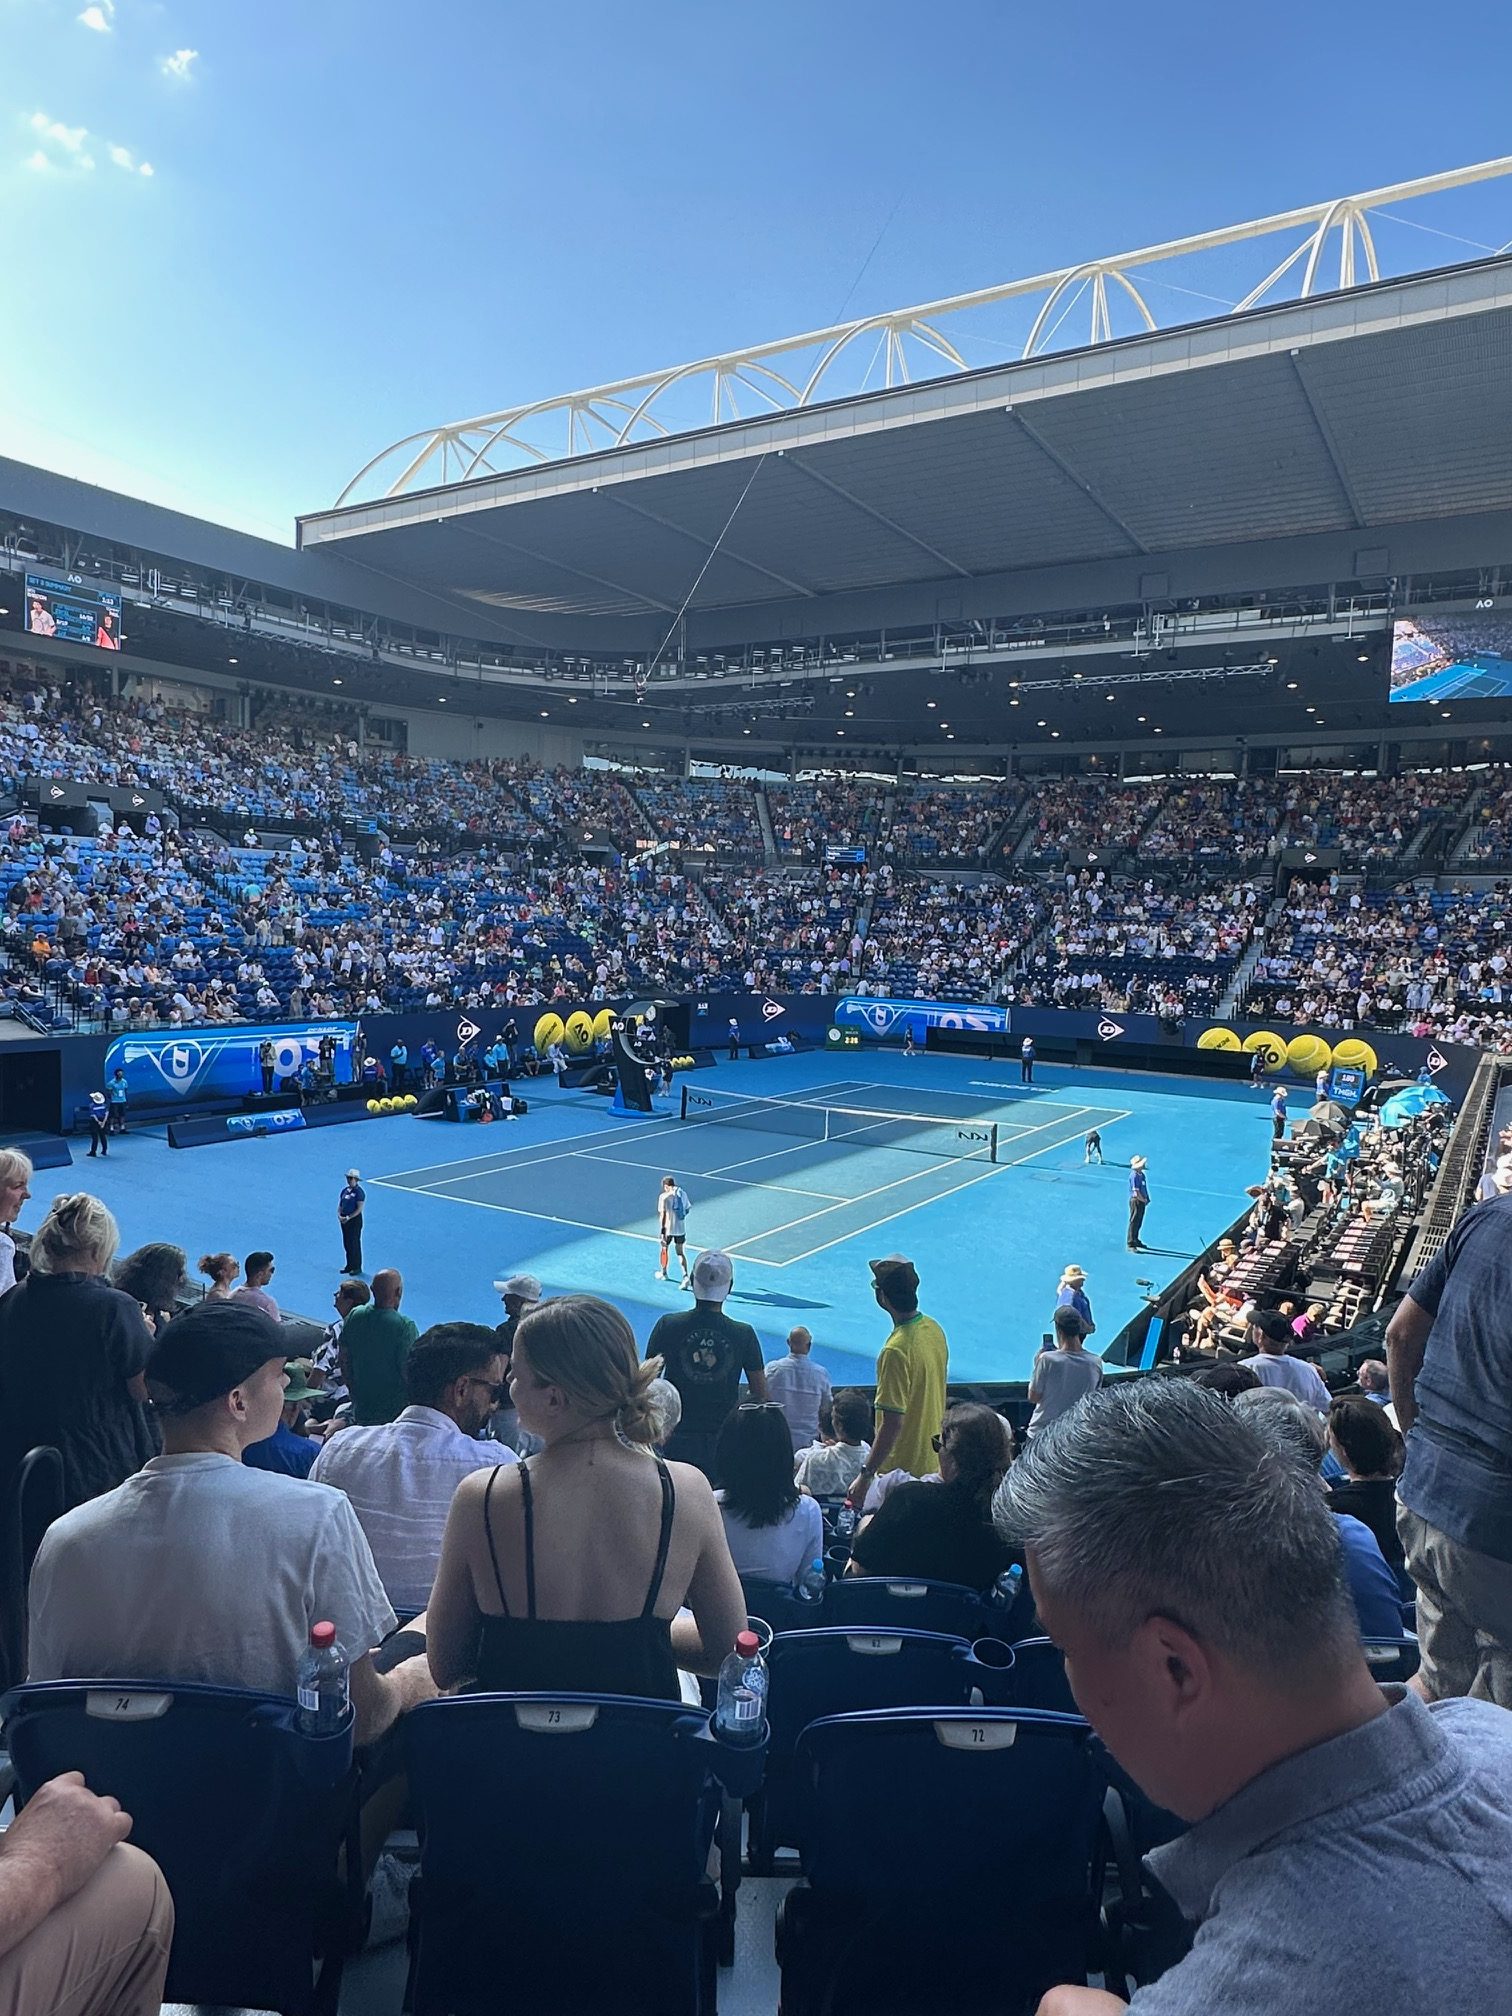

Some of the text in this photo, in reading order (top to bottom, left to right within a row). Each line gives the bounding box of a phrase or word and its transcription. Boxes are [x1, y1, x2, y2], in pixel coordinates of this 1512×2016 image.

[67, 574, 83, 584] AO
[1475, 599, 1494, 609] AO
[612, 1021, 625, 1031] AO
[700, 1338, 715, 1347] AO
[115, 1697, 130, 1711] 74
[548, 1710, 560, 1723] 73
[972, 1728, 985, 1742] 72
